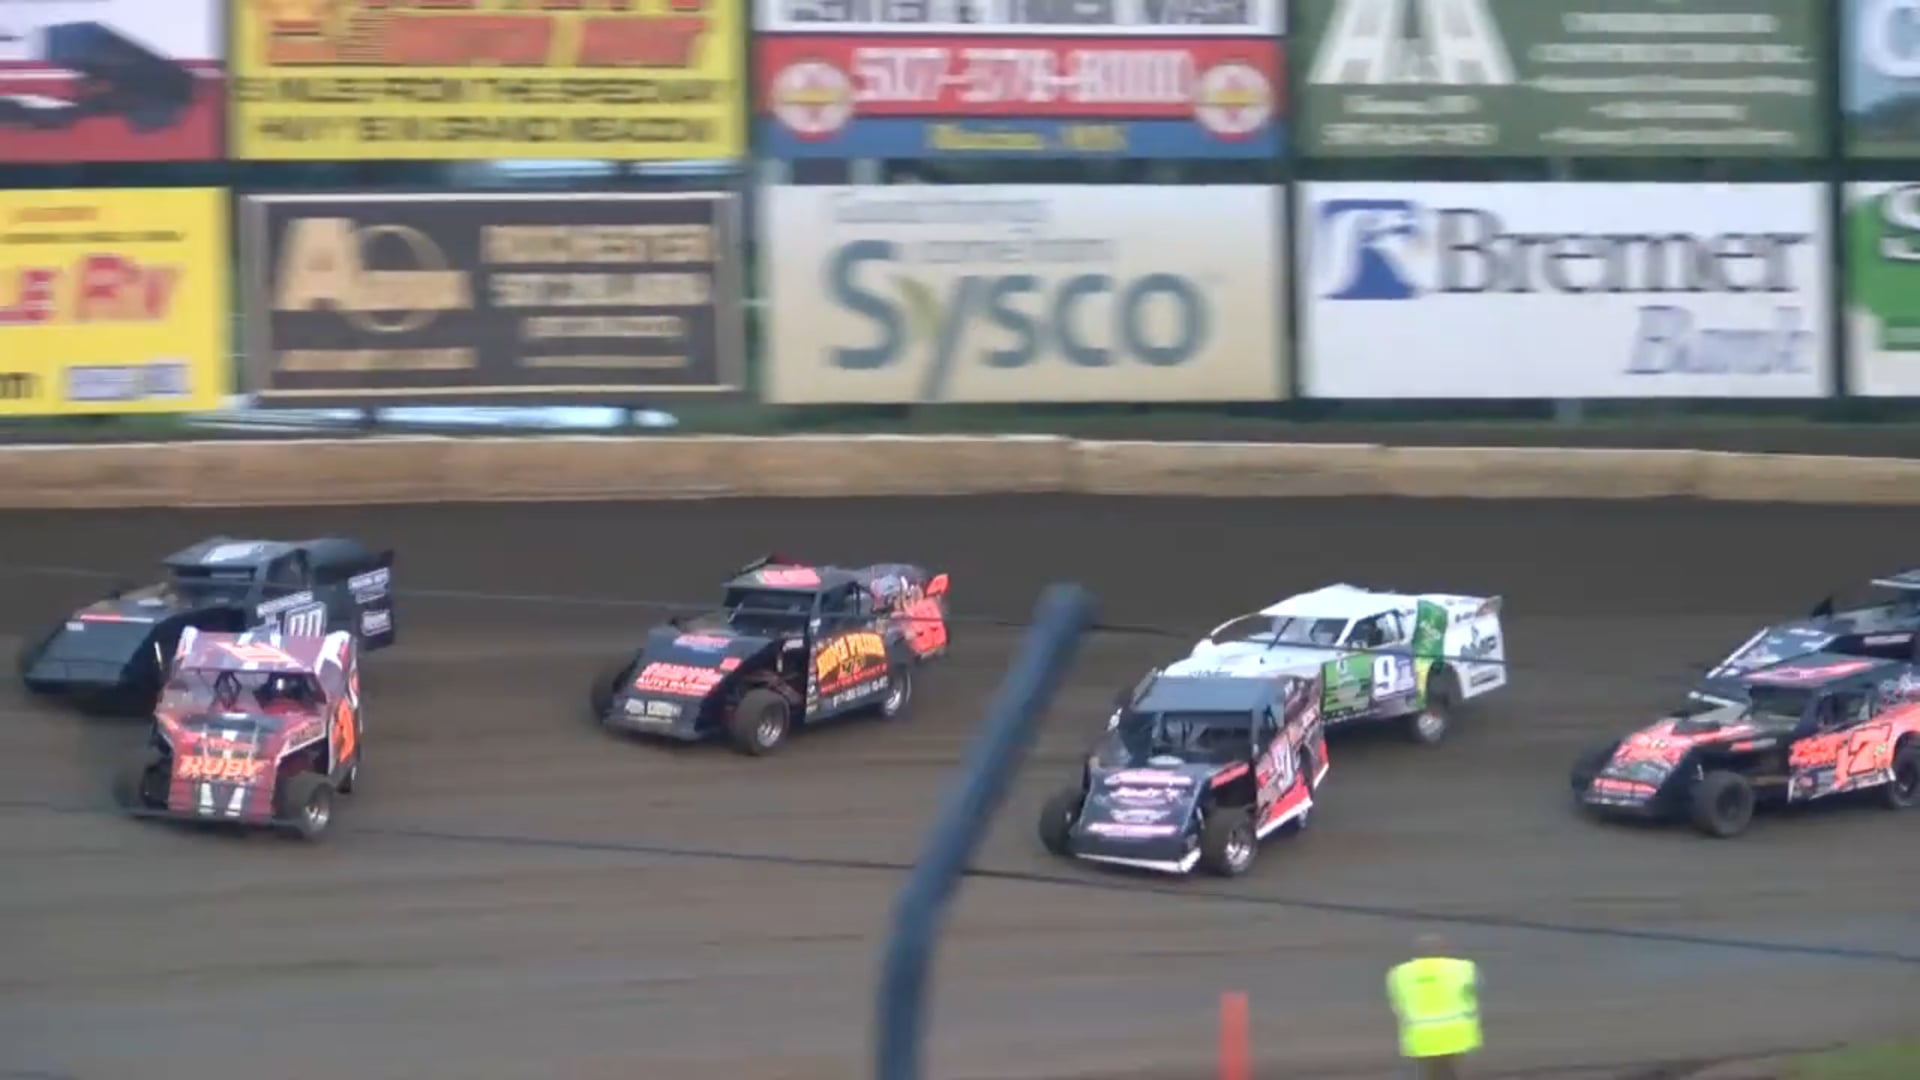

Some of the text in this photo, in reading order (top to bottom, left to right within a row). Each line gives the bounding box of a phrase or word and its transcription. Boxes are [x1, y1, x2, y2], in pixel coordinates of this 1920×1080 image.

[1434, 206, 1812, 294] Bremer
[826, 239, 1213, 402] Sysco
[1622, 304, 1814, 375] Bank
[177, 756, 269, 777] RUBY
